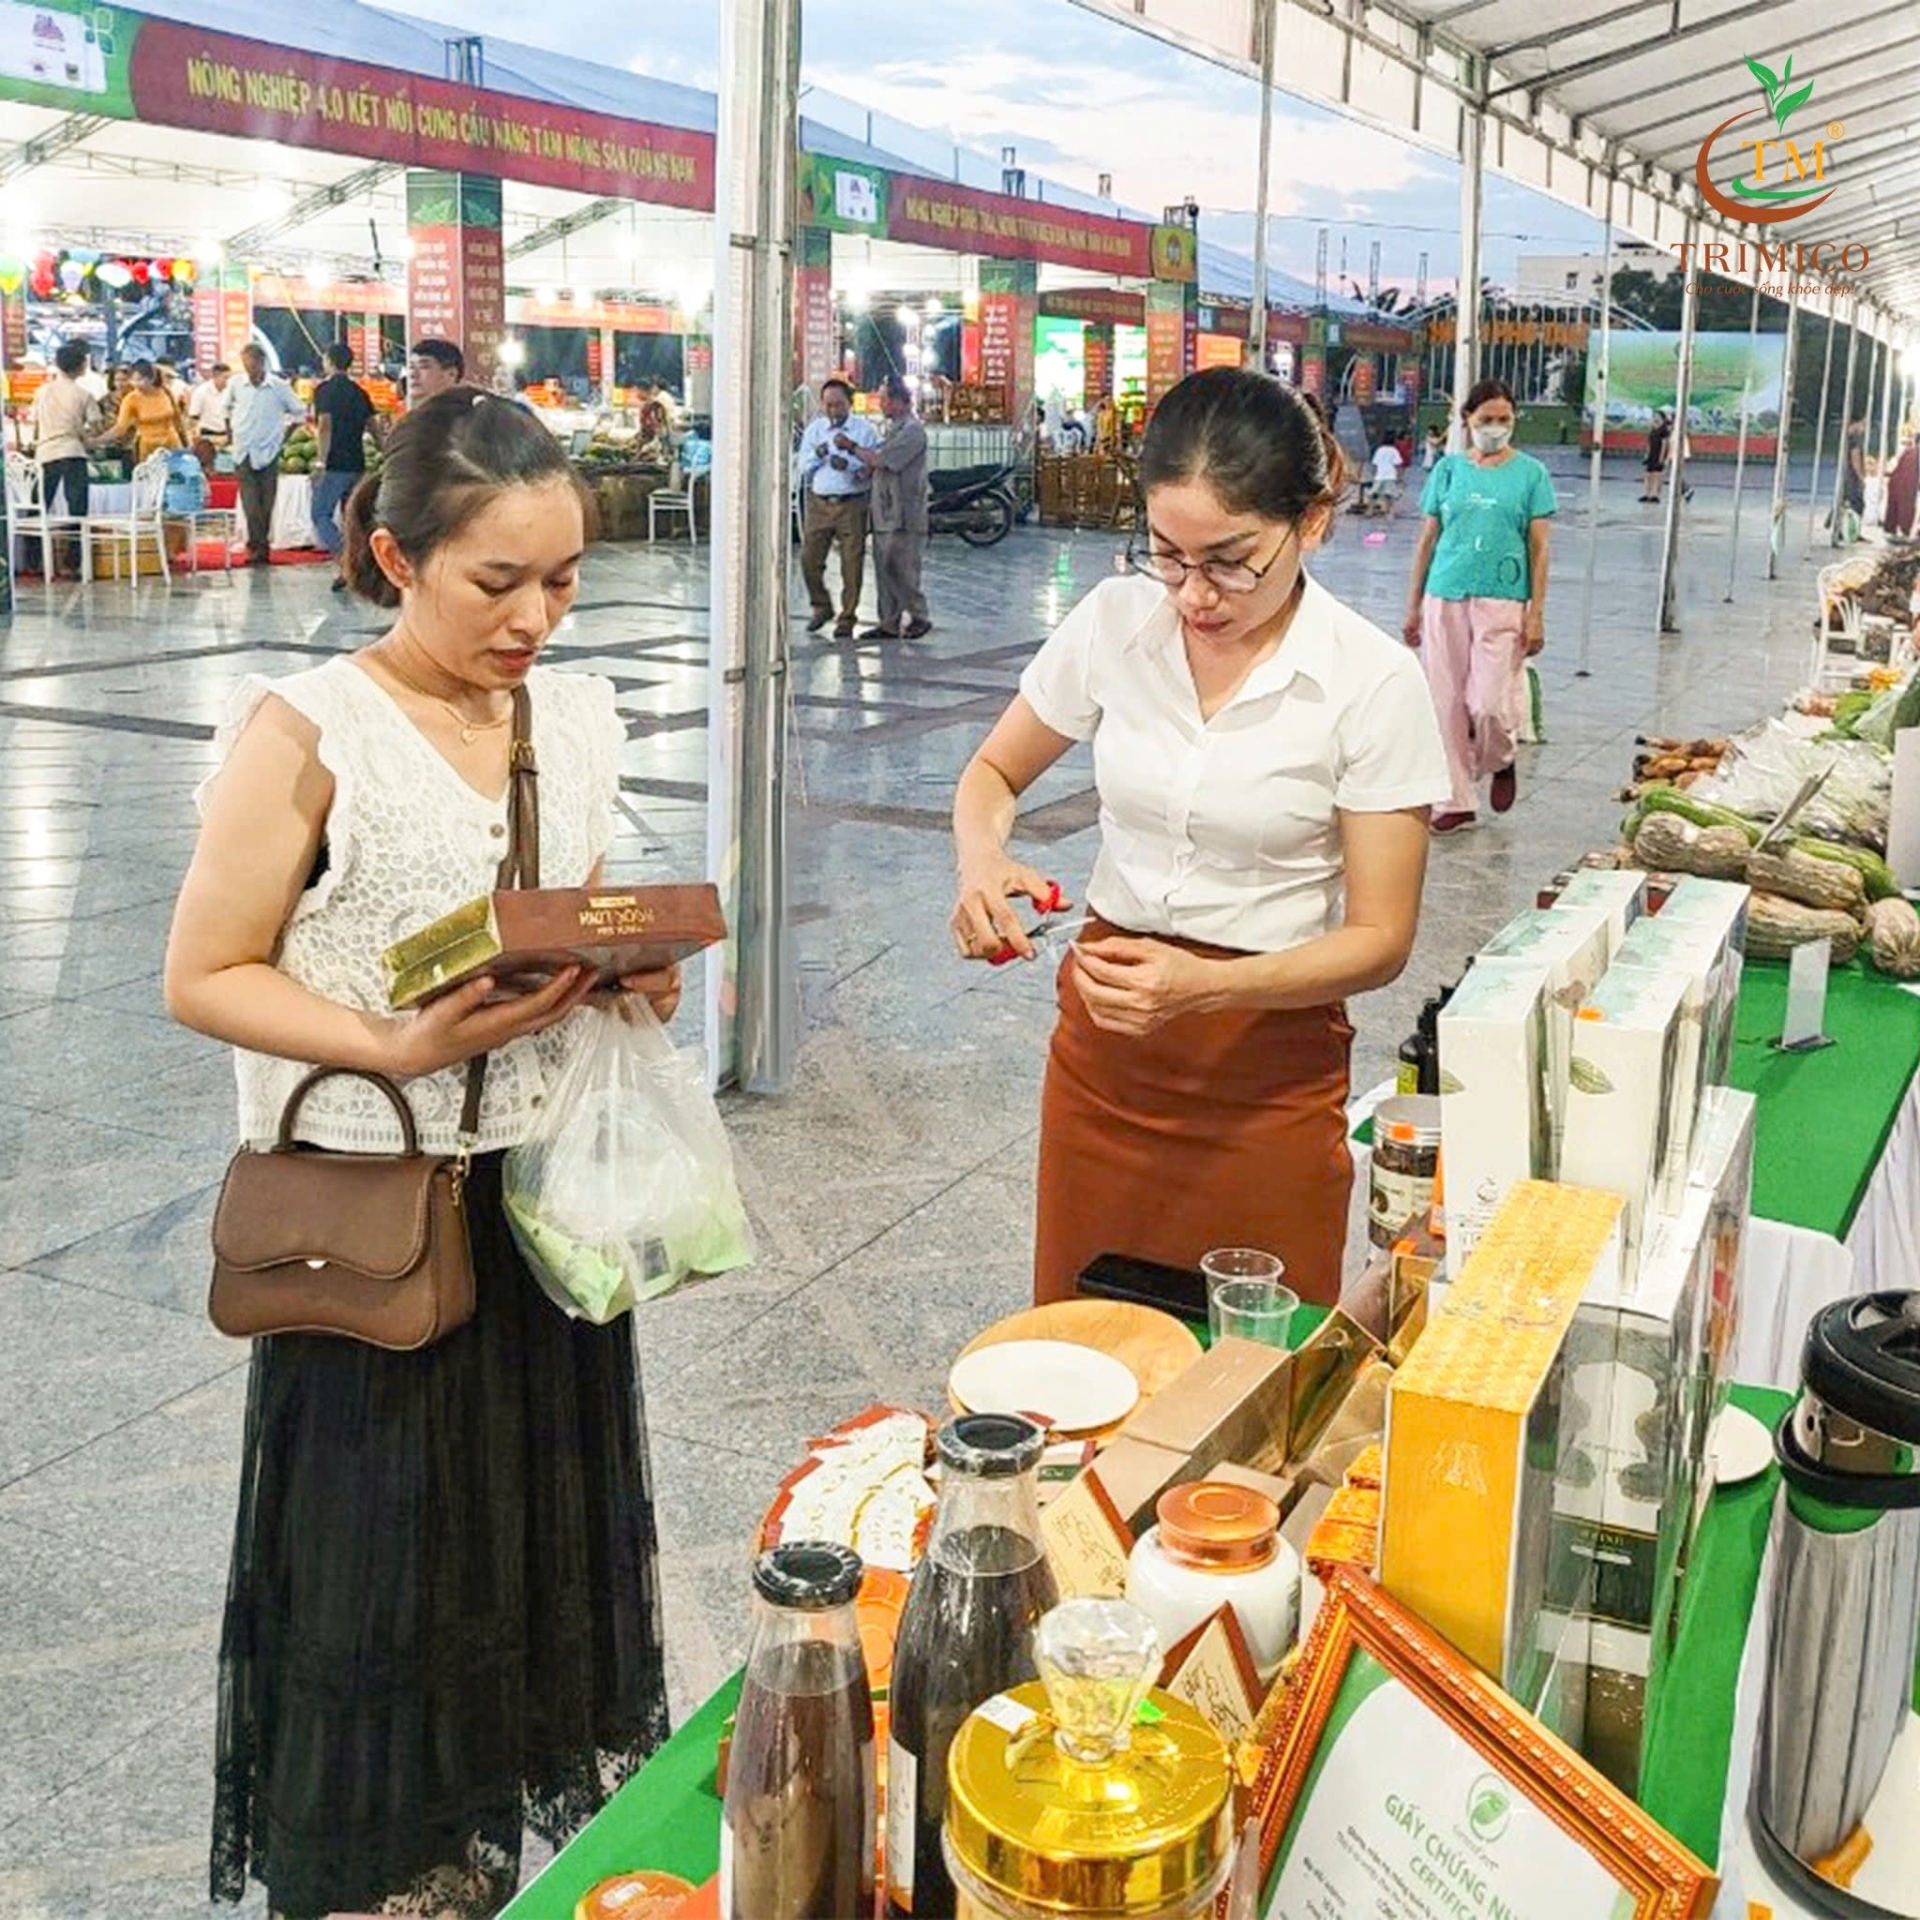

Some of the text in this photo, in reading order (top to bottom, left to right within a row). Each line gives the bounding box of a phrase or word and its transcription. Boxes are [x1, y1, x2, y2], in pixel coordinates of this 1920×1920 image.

[187, 52, 241, 102] NÔNG
[244, 68, 311, 121] NGHIỆP
[317, 85, 344, 121] 4.0
[346, 80, 380, 127] KẾT
[384, 86, 413, 133] NỐI
[417, 104, 457, 139] CUNG
[1385, 1794, 1426, 1839] GIẤY
[1426, 1833, 1488, 1905] CHỨNG
